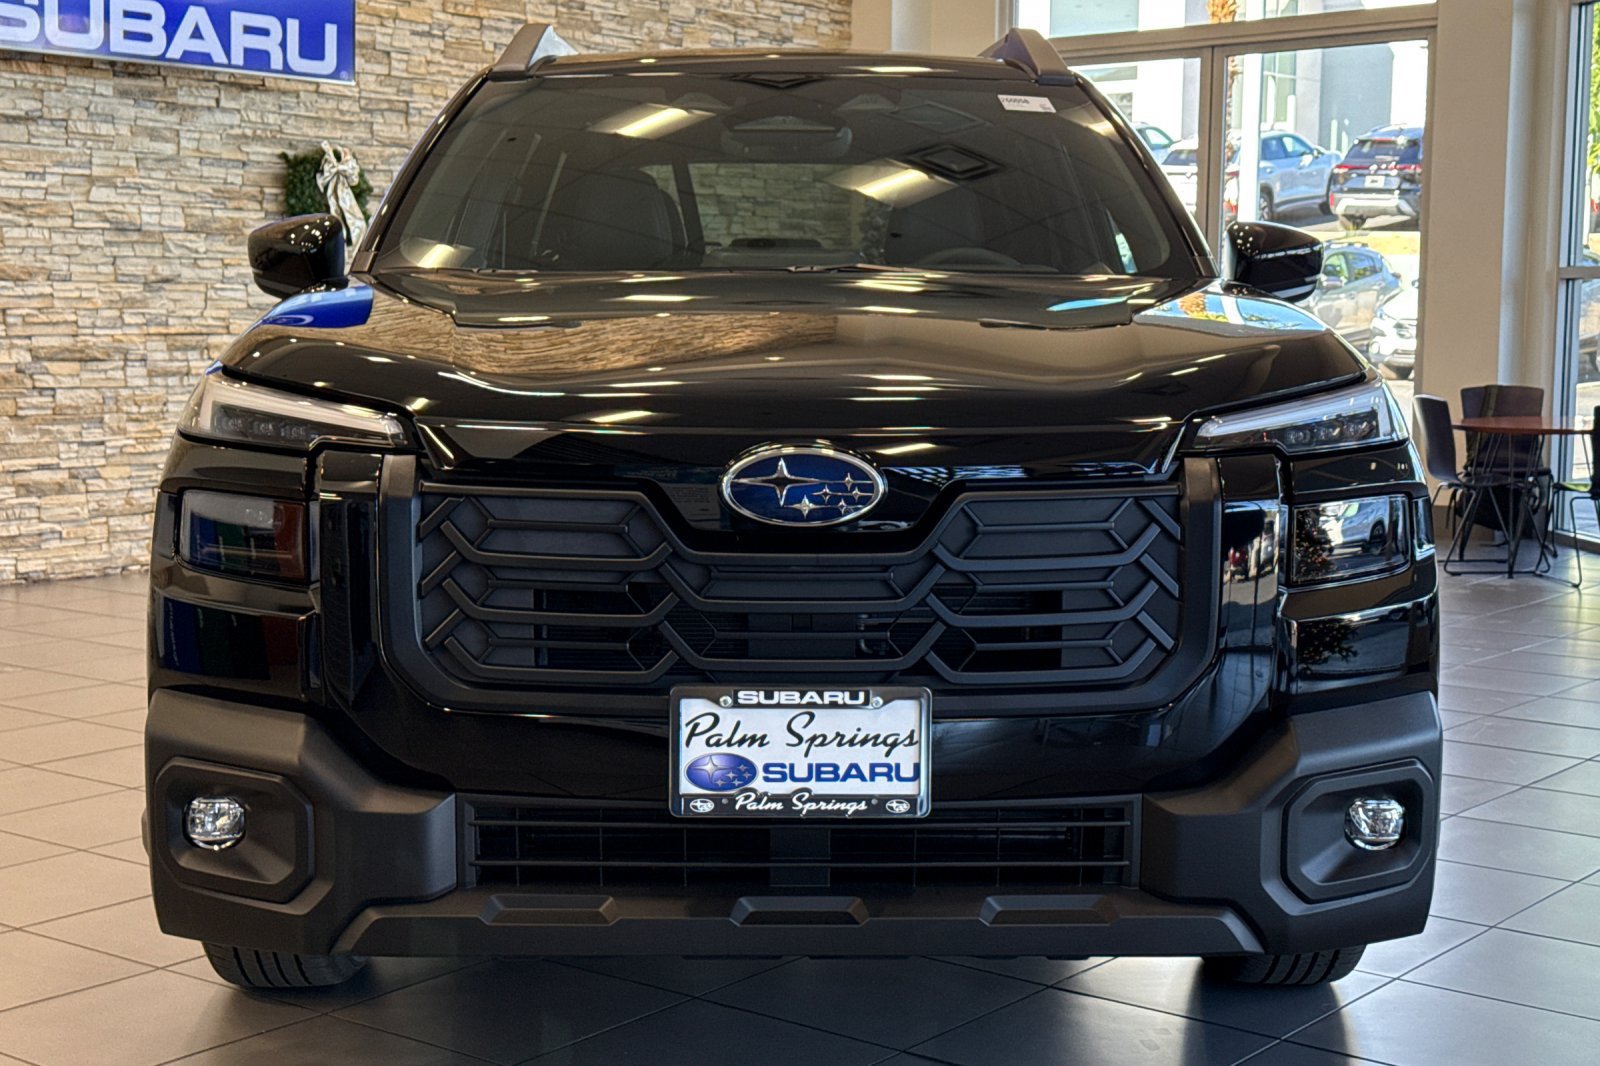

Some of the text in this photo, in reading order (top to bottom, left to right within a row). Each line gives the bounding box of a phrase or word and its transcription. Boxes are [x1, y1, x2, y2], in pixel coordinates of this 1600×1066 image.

[0, 0, 338, 75] SUBARU
[737, 690, 865, 705] SUBARU
[685, 710, 919, 758] Palm Springs
[762, 762, 920, 783] SUBARU
[734, 791, 868, 818] Palm Springs
